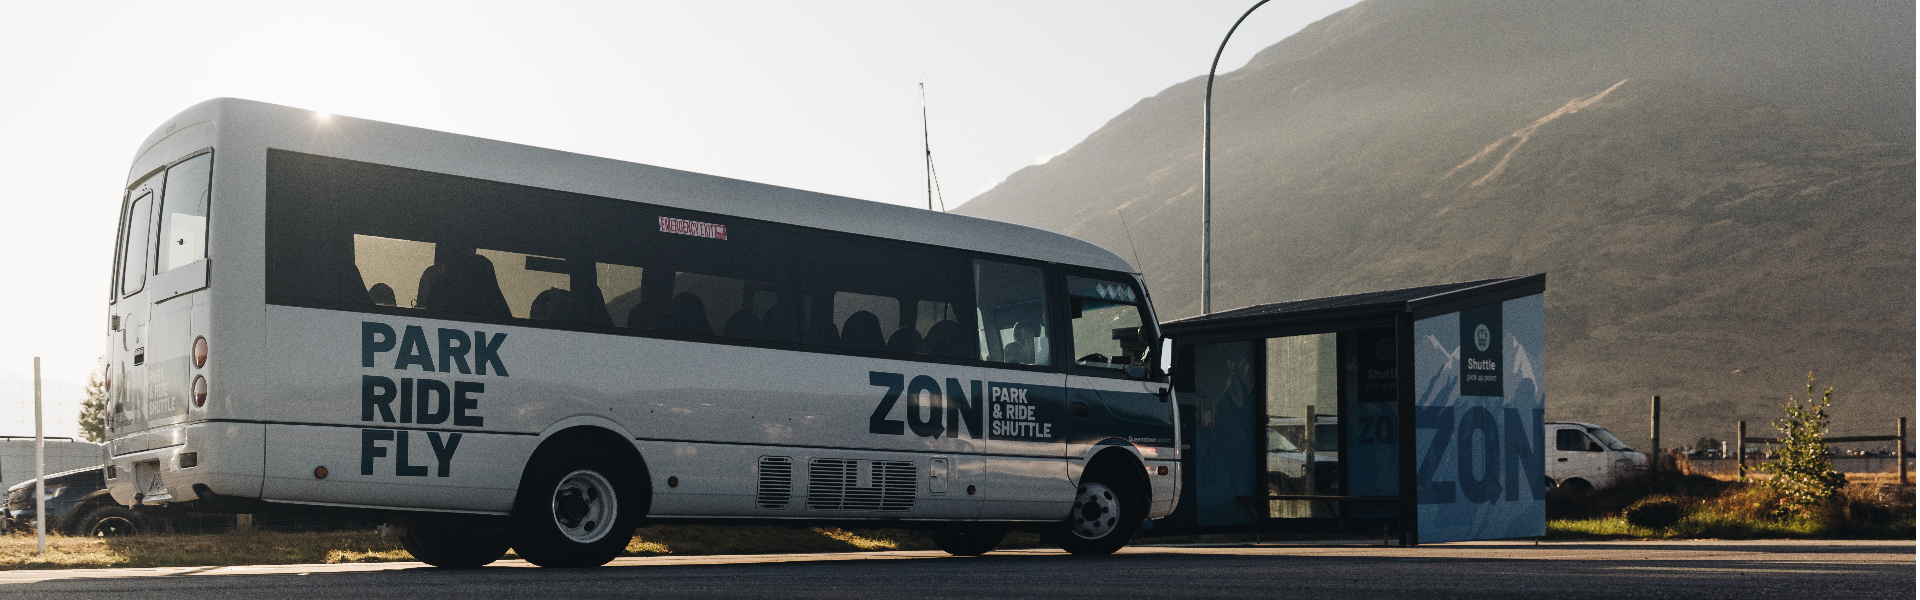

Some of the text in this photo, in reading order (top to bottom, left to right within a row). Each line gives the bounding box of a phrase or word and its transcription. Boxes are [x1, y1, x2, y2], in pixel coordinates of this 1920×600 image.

[660, 217, 715, 238] EMERGENCY EXIT
[362, 321, 509, 377] PARK
[1367, 366, 1398, 380] Shuttl
[1467, 357, 1496, 371] Shuttle
[1466, 373, 1477, 382] pick
[1484, 374, 1497, 382] point
[362, 375, 485, 427] RIDE
[992, 386, 1028, 404] PARK
[149, 396, 175, 415] SHUTTLE
[869, 371, 983, 440] ZQN
[992, 404, 1036, 421] & RIDE
[992, 420, 1052, 438] SHUTTLE
[1128, 435, 1157, 443] Queenstown
[361, 429, 463, 477] FLY
[1415, 405, 1545, 506] ZQN
